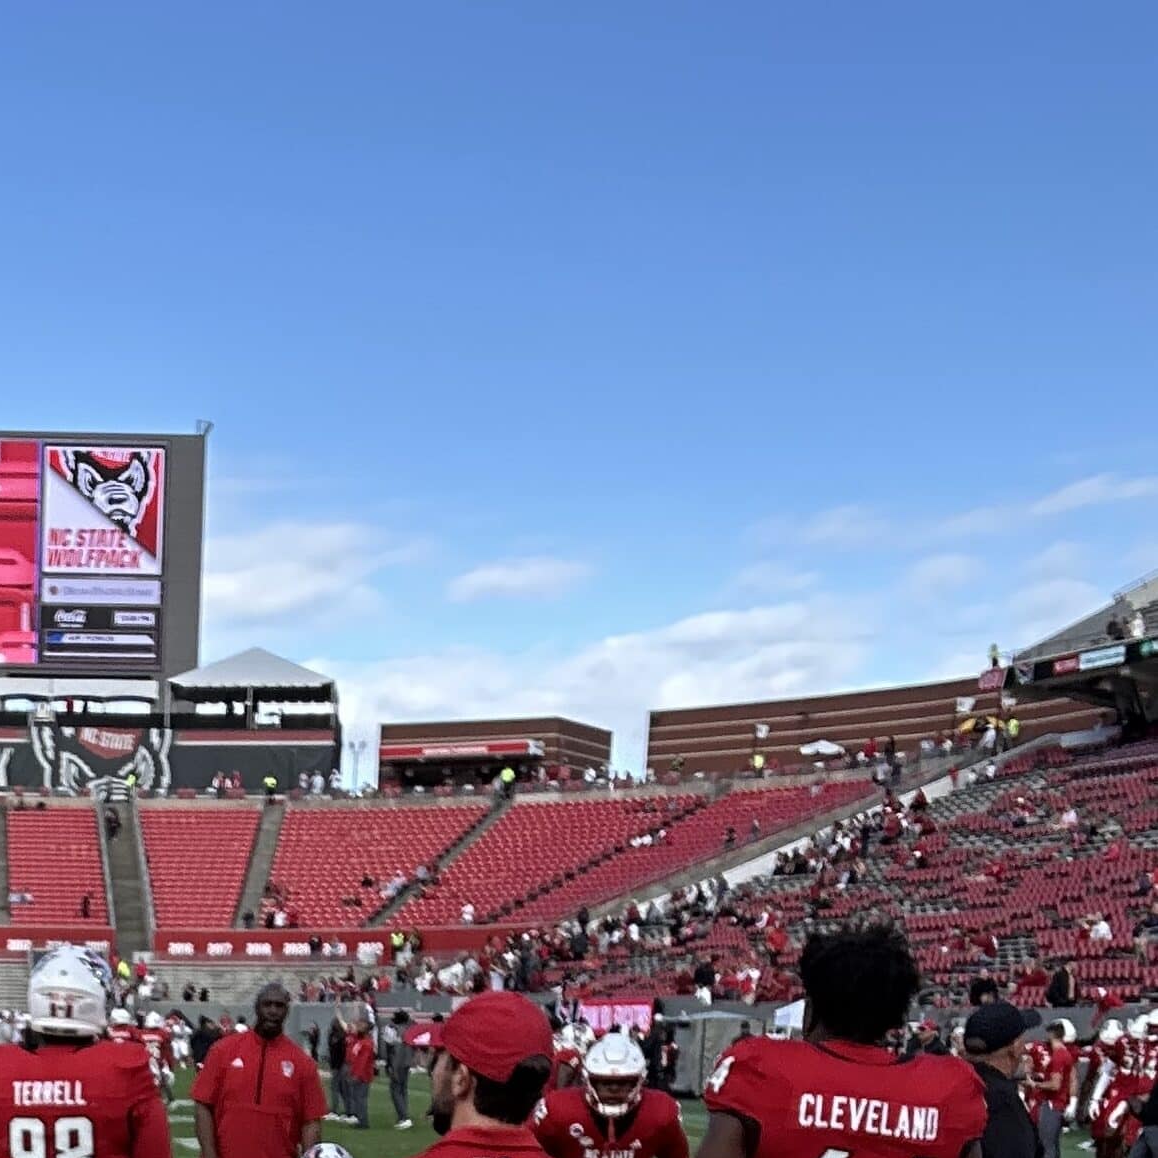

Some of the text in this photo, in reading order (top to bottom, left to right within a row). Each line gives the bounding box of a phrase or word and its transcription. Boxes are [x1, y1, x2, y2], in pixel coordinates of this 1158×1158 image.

[48, 528, 126, 548] NC STATE
[47, 548, 140, 569] WOLFPACK
[12, 1080, 87, 1106] TERRELL
[798, 1093, 939, 1141] CLEVELAND
